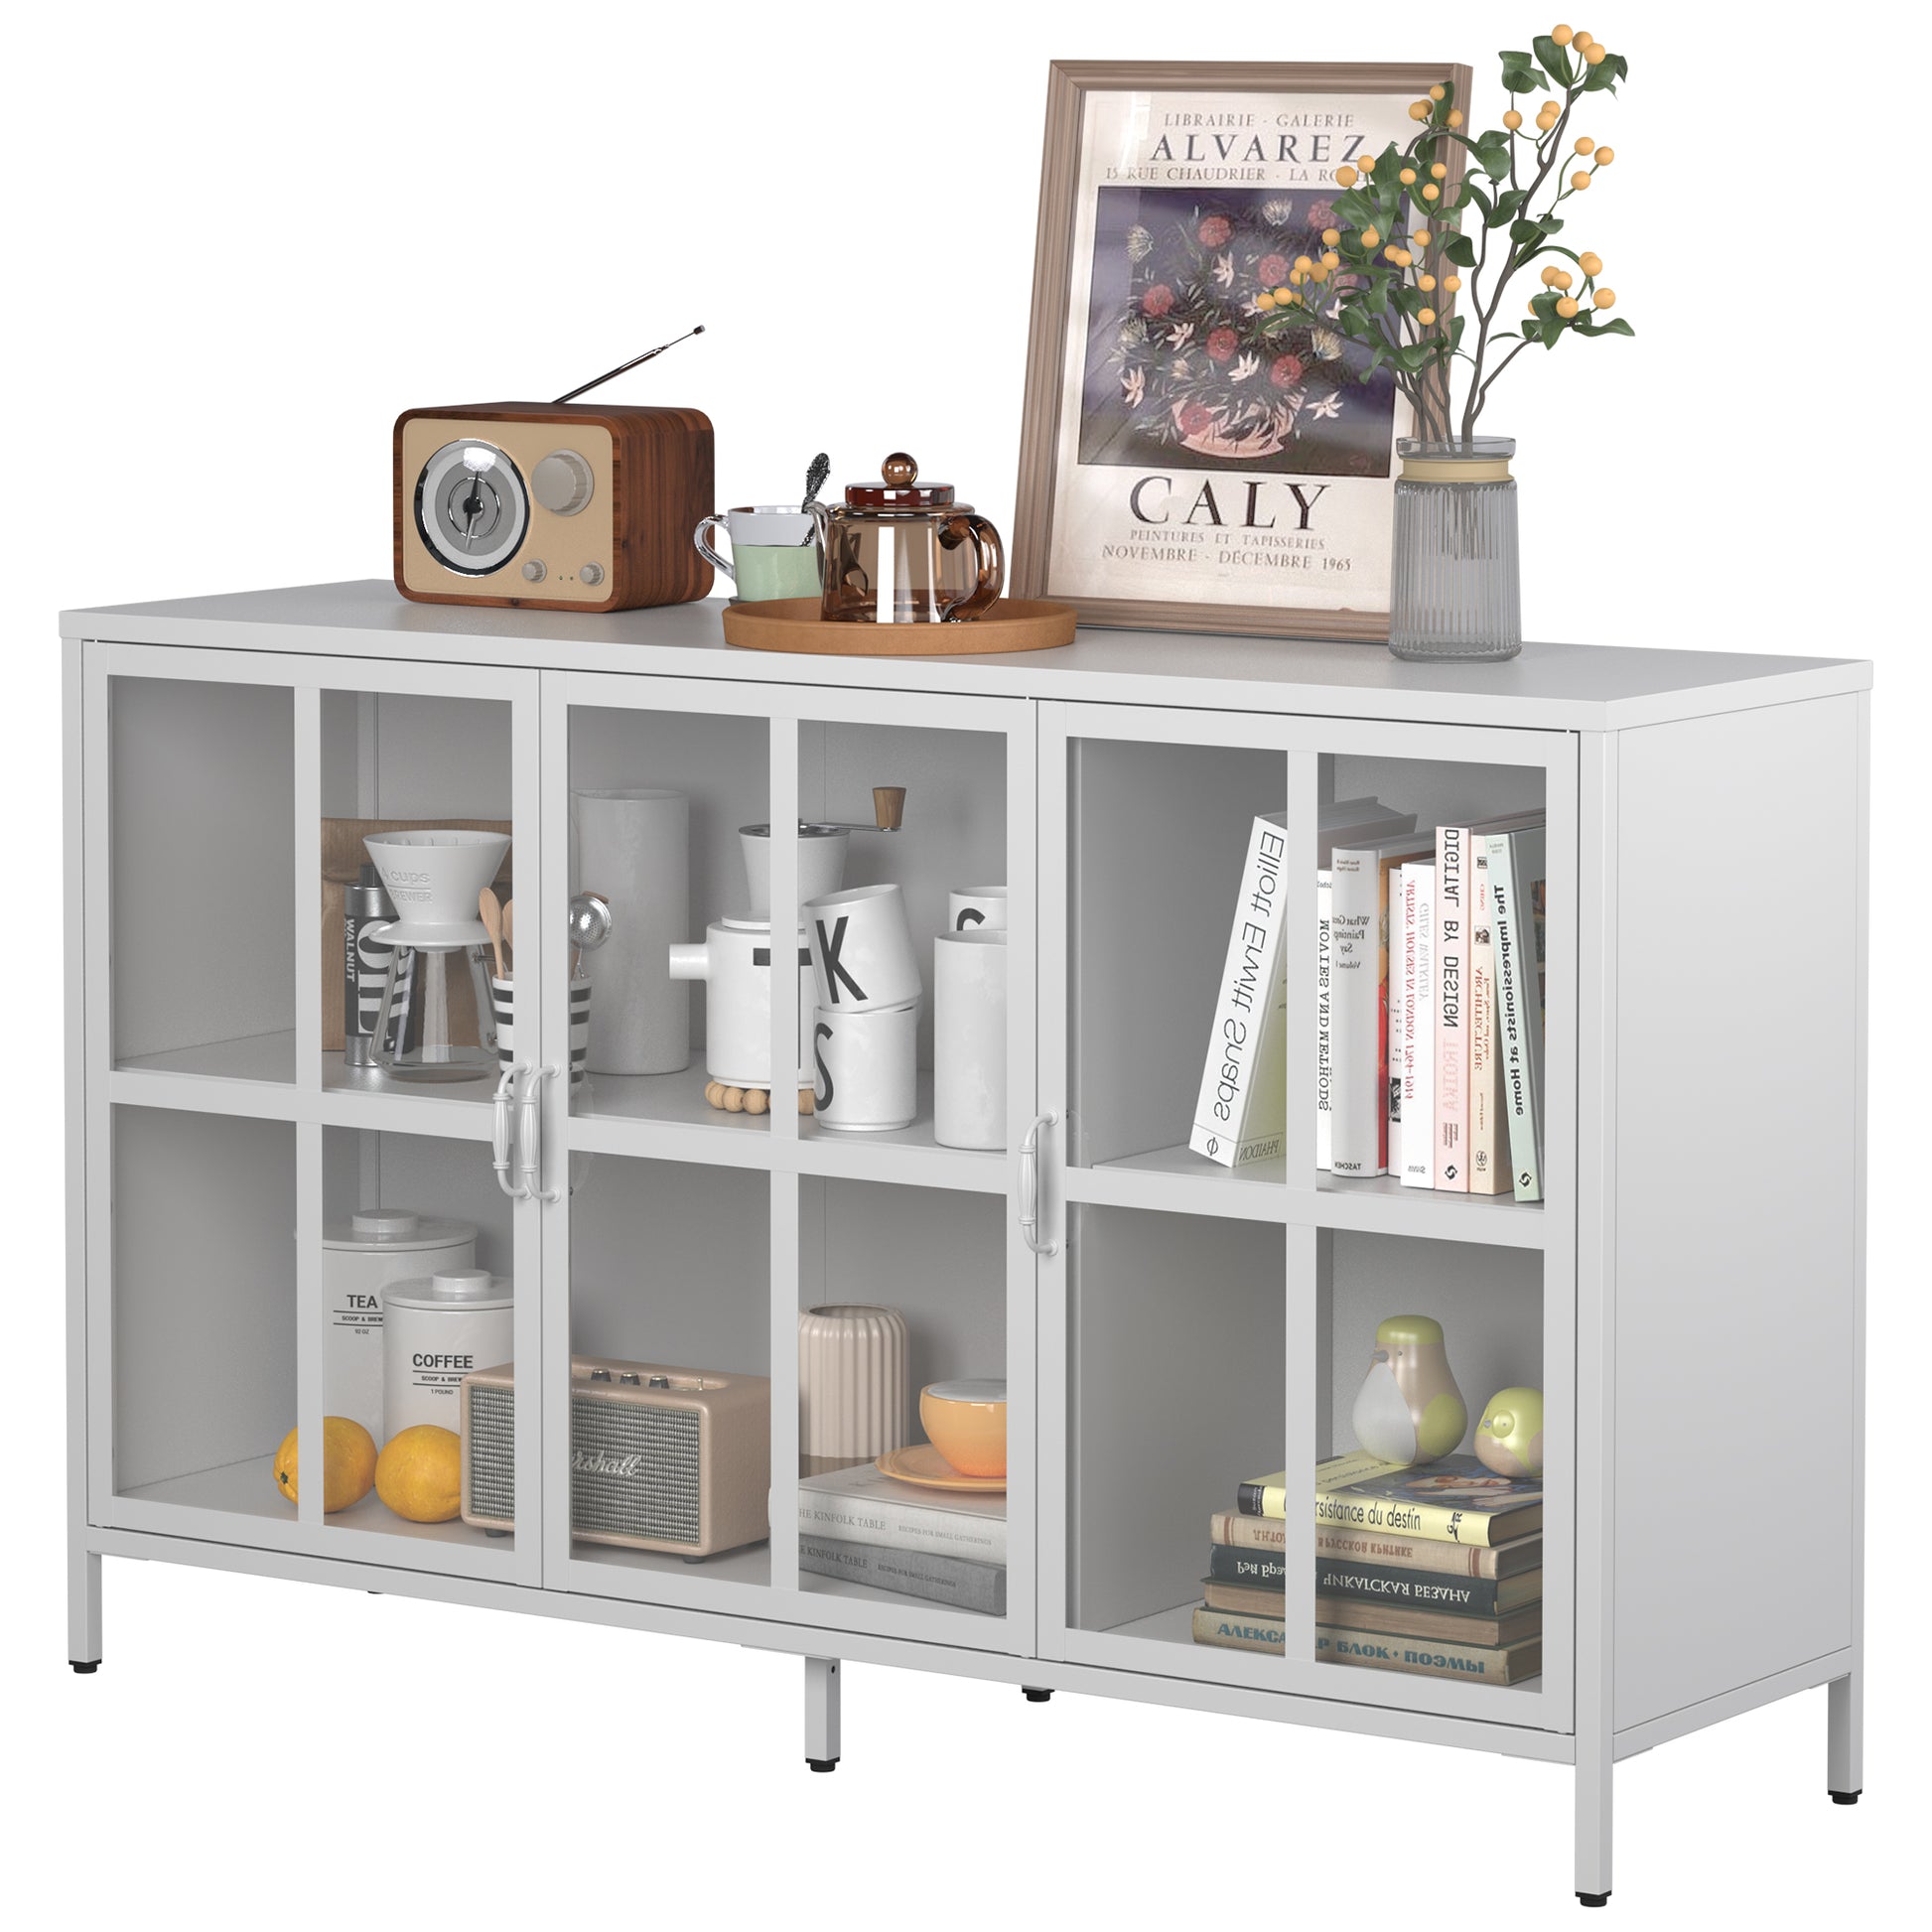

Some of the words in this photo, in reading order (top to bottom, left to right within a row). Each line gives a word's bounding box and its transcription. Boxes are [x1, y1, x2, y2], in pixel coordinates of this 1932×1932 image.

[1165, 113, 1255, 127] LIBRAIRIE
[1276, 113, 1354, 128] GALERIE
[1150, 133, 1366, 164] ALVAREZ
[1106, 167, 1119, 180] 15
[1127, 167, 1159, 180] RUE
[1167, 168, 1266, 182] CHAUDRIER
[1290, 169, 1309, 182] LA
[1129, 476, 1331, 531] CALY
[1130, 529, 1204, 544] PEINTURES
[1215, 534, 1230, 545] ET
[1243, 533, 1326, 551] TAPISSERIES
[1102, 545, 1197, 563] NOVEMBRE
[1321, 557, 1352, 572] 1965
[345, 918, 355, 983] WALNUT
[815, 916, 869, 1005] K
[814, 1023, 834, 1112] S
[346, 1294, 378, 1309] TEA
[412, 1353, 474, 1369] COFFEE
[572, 1449, 642, 1477] rshall
[799, 1509, 812, 1519] HE
[814, 1511, 856, 1526] KINFOLK
[857, 1517, 887, 1530] TABLE
[1367, 1501, 1384, 1526] du
[1386, 1504, 1422, 1531] destin
[806, 1546, 842, 1563] KINFOLK
[843, 1555, 869, 1569] TABLE
[1336, 1640, 1390, 1662] БЛОК
[1404, 1649, 1485, 1675] ПОЭМЫ
